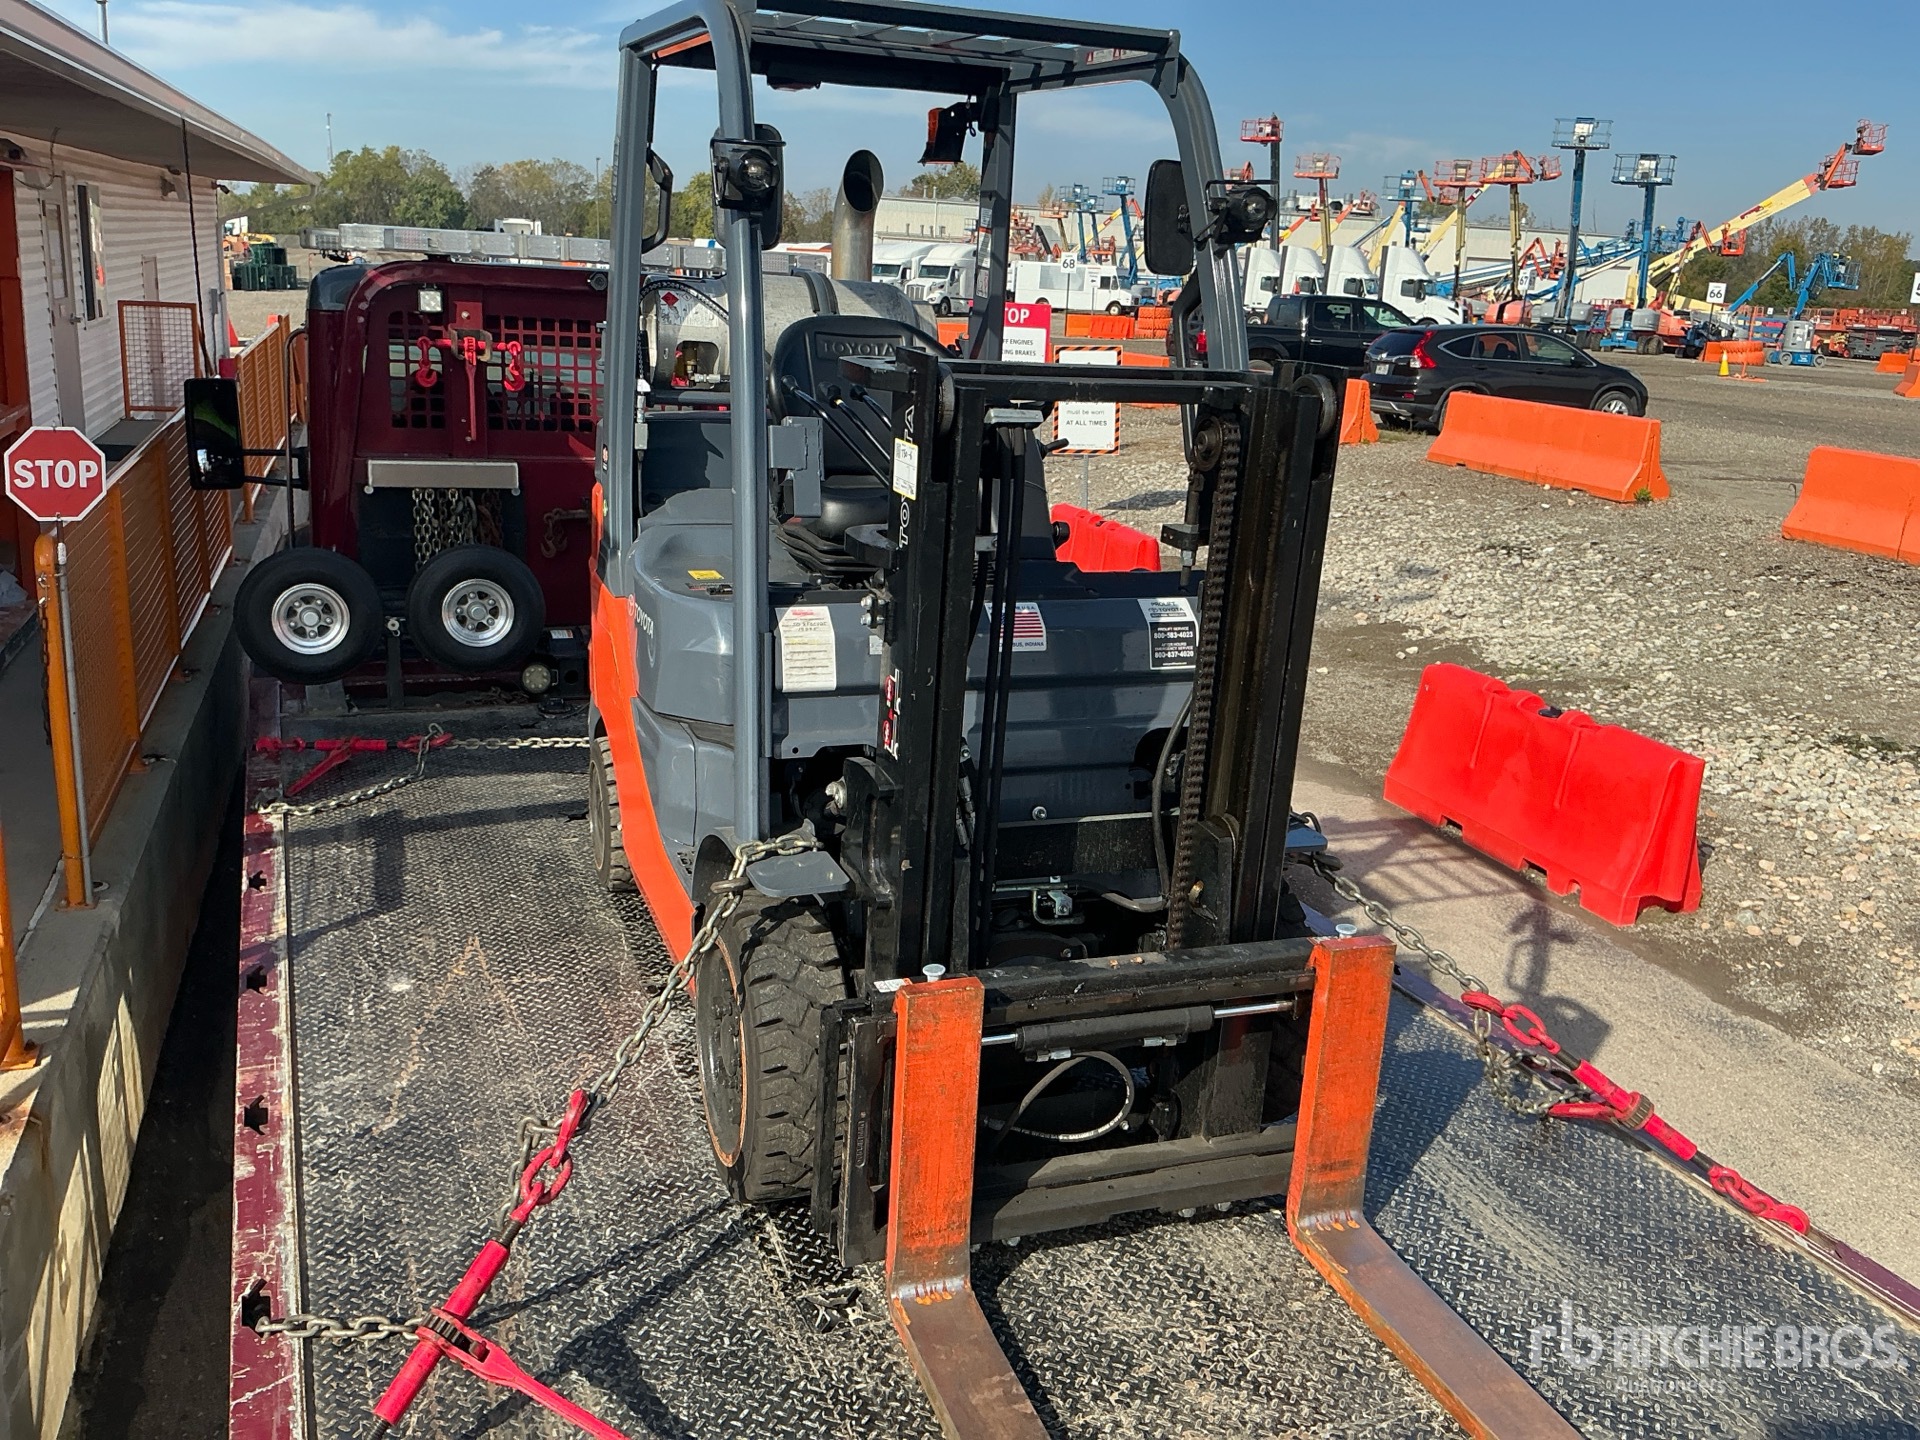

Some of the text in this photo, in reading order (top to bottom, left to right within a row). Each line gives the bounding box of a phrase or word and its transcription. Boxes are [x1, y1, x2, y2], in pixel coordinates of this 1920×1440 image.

[1062, 259, 1076, 269] 68
[1519, 276, 1529, 286] 67
[1709, 289, 1723, 299] 66
[1005, 308, 1030, 324] OP
[822, 342, 895, 356] TOYOTA
[13, 459, 99, 489] STOP
[898, 405, 915, 549] TOTA
[634, 602, 654, 639] TOYOTA
